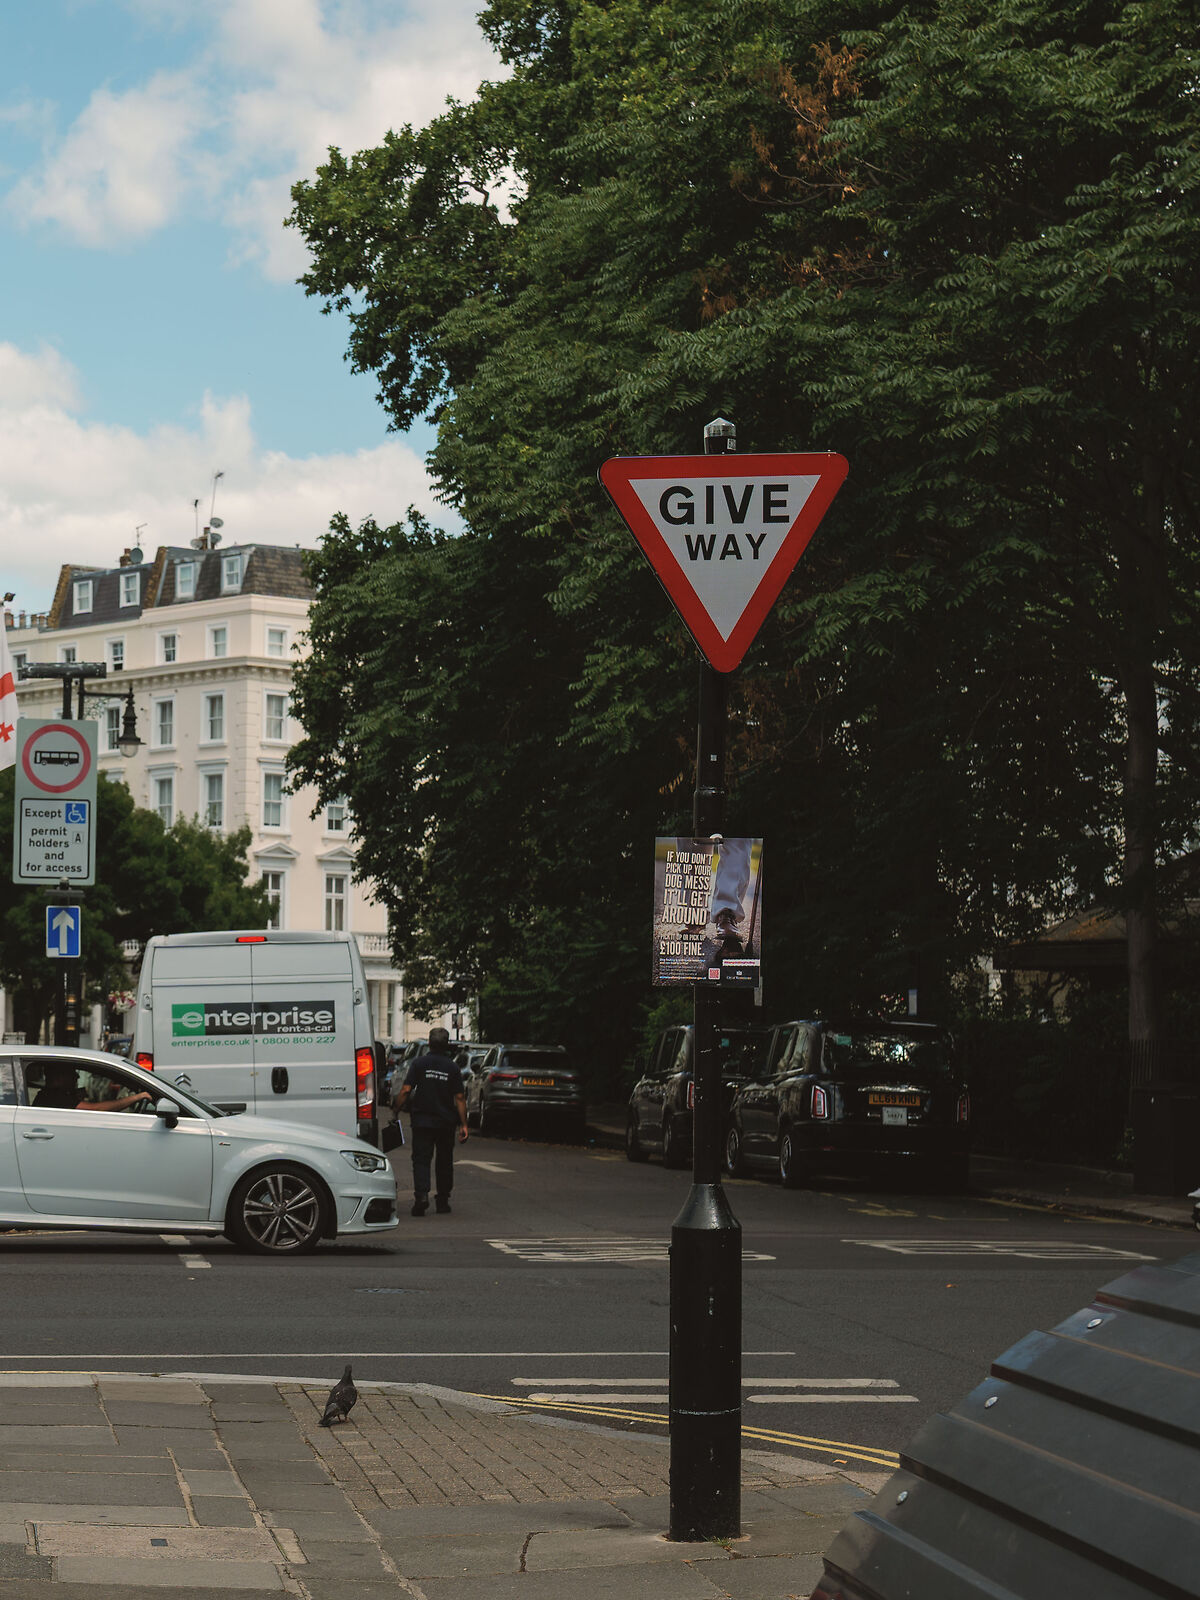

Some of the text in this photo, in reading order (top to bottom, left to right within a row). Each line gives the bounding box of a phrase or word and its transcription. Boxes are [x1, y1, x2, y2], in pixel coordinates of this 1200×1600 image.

[659, 483, 790, 525] GIVE
[684, 533, 767, 561] WAY
[24, 808, 62, 819] Except
[31, 826, 67, 836] permit
[74, 833, 82, 843] A
[28, 838, 70, 848] holders
[44, 851, 64, 860] and
[666, 850, 713, 865] IF YOU DON'T
[26, 862, 82, 873] for access
[665, 862, 712, 876] PICK UP YOUR
[665, 874, 683, 888] DOG
[663, 888, 711, 908] IT'LL GET
[661, 905, 708, 926] AROUND
[659, 940, 705, 956] £100 FINE.
[180, 1006, 333, 1031] enterprise
[277, 1024, 333, 1033] rent-a-car
[171, 1036, 336, 1048] enterprise.co.uk 0800 800 227
